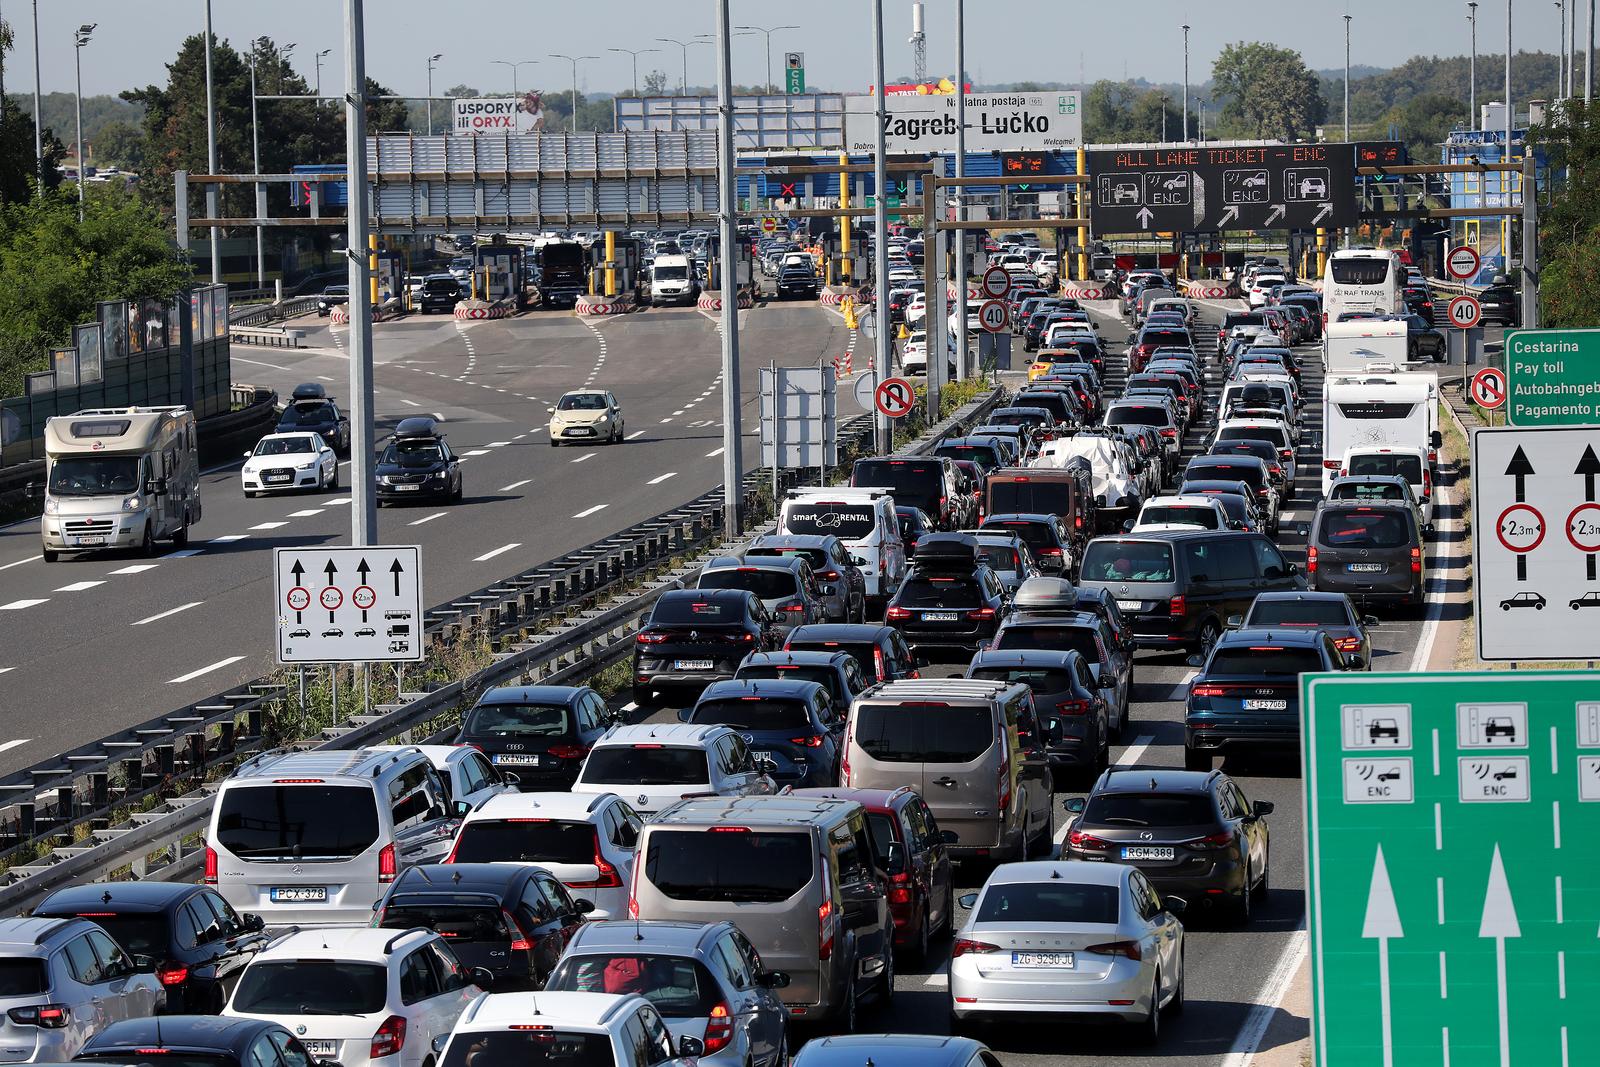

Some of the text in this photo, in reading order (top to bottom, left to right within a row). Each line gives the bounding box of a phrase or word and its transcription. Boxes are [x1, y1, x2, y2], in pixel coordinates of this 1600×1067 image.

[992, 96, 1026, 107] postaja
[458, 116, 515, 128] ili ORYX.
[884, 113, 956, 140] Zagreb
[981, 112, 1049, 134] Lučko
[1116, 152, 1148, 166] ALL
[1156, 151, 1199, 165] LANE
[1207, 148, 1267, 164] TICKET
[1293, 147, 1326, 161] ENC
[1153, 192, 1181, 204] ENC
[1232, 190, 1261, 202] ENC
[986, 308, 1003, 324] 40
[1455, 304, 1474, 320] 40
[1514, 340, 1579, 354] Cestarina
[1515, 361, 1564, 377] Pay toll
[1516, 402, 1591, 418] Pagamento
[792, 513, 870, 522] smart RENTAL
[1367, 786, 1391, 796] ENC
[1483, 785, 1507, 796] ENC
[1128, 848, 1172, 857] RGM-389
[278, 888, 324, 899] PCX-378
